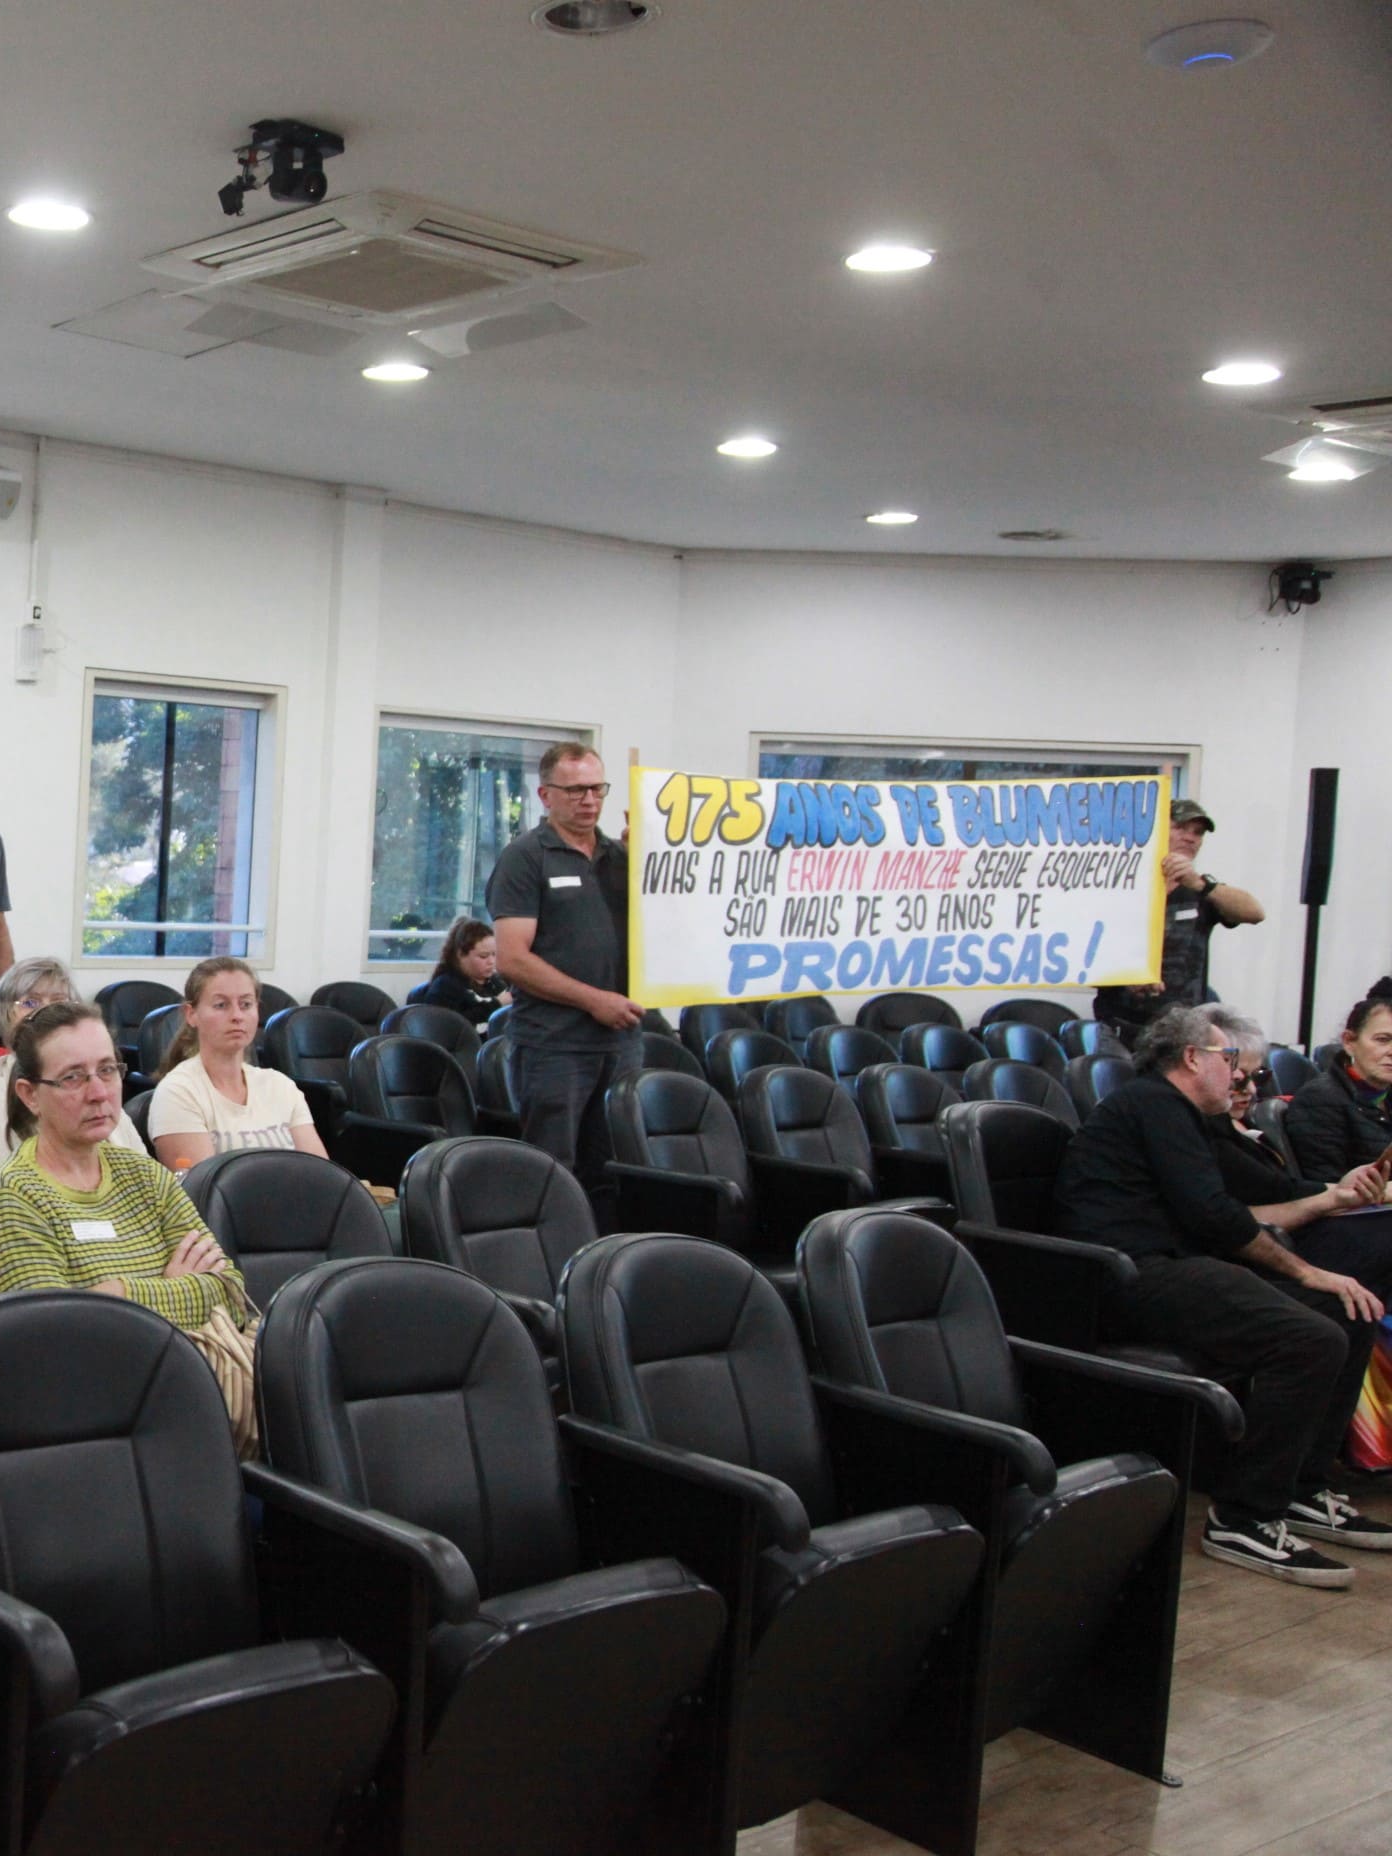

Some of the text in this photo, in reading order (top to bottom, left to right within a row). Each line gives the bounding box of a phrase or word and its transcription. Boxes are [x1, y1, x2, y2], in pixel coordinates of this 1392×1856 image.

[656, 772, 1159, 849] 175 ANOS DE BLUMENAU
[642, 848, 1142, 896] MAS A RUA ERWIN MANZKE SEGUE ESQUECIDA
[723, 893, 1042, 939] SÃO MAIS DE 30 ANOS DE
[728, 932, 1069, 995] PROMESSAS
